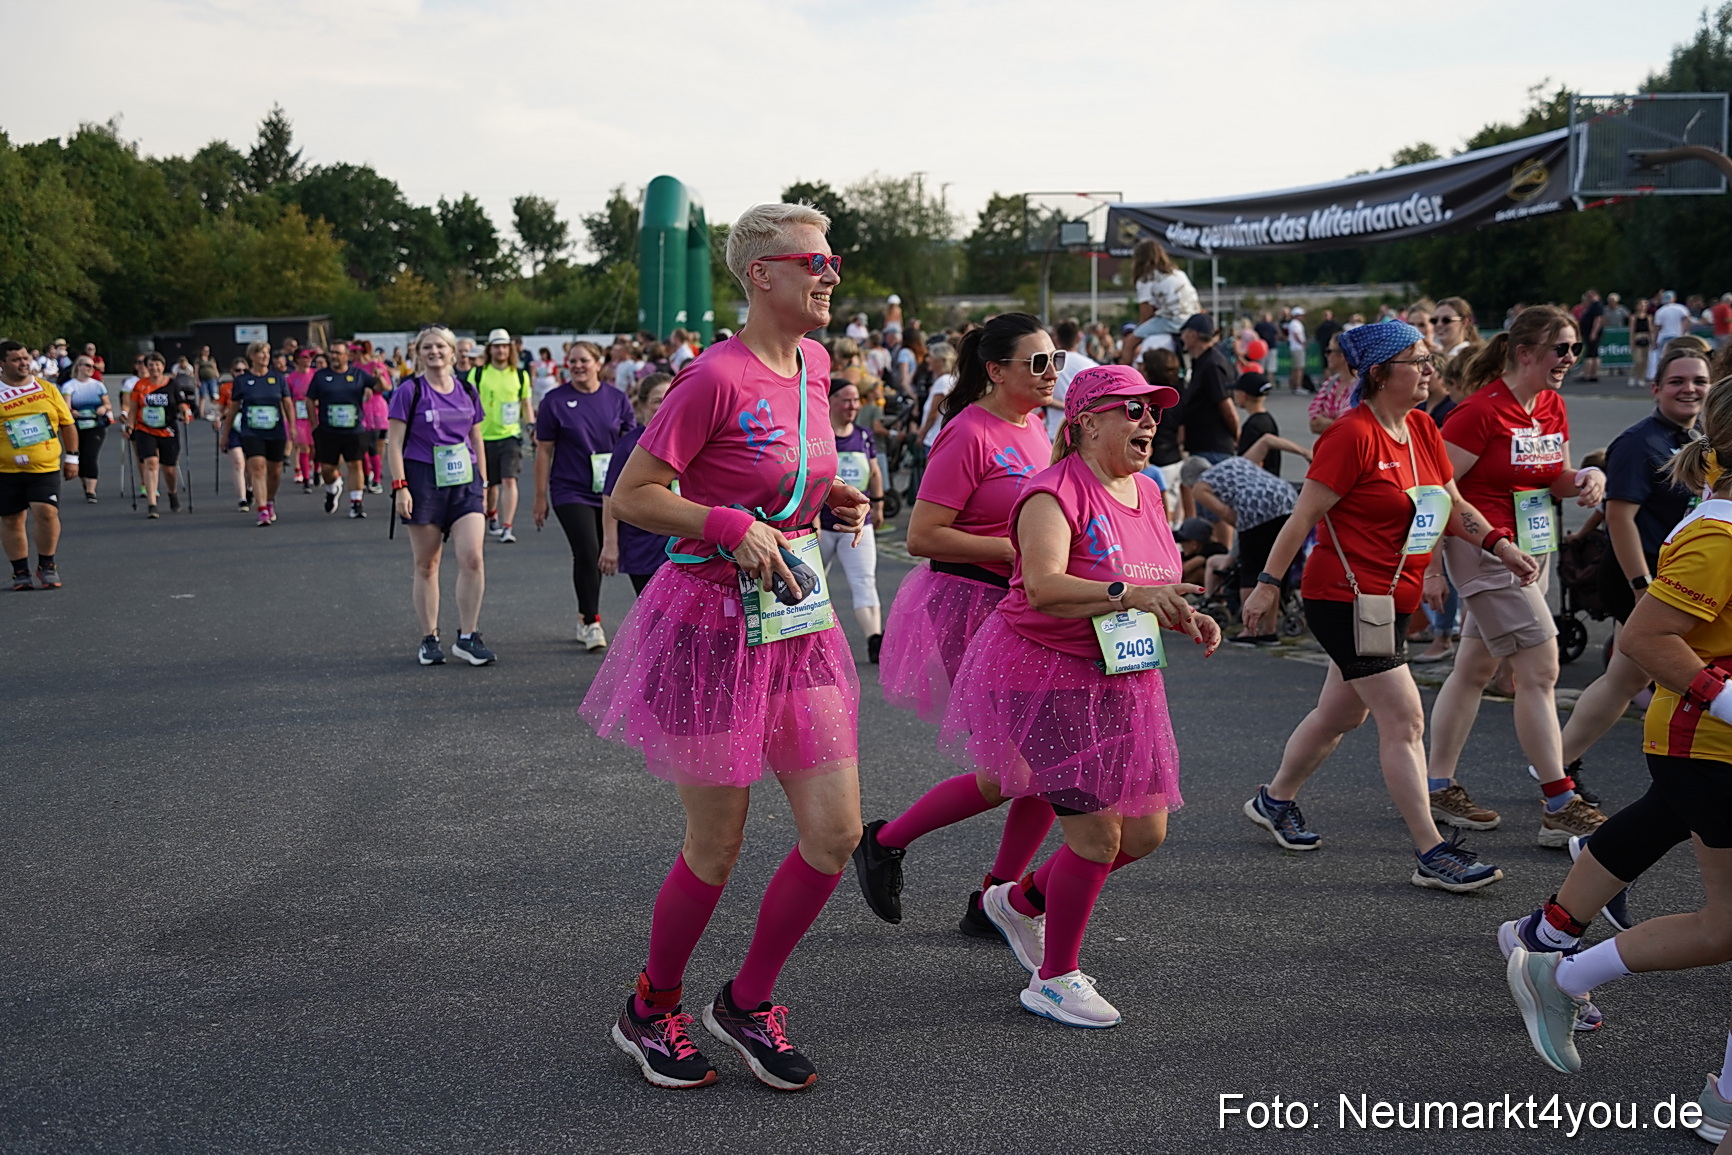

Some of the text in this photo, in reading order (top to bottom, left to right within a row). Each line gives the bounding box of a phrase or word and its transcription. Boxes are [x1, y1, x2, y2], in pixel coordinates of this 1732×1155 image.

[1166, 192, 1454, 254] Hier gewinnt das Miteinander.
[4, 393, 50, 411] MAX BÖGL
[22, 427, 39, 436] 1718
[447, 461, 463, 471] 819
[1416, 514, 1435, 528] 87
[762, 609, 785, 620] Denise
[1115, 638, 1155, 660] 2403
[1115, 659, 1160, 673] Loredana Stengel
[1041, 984, 1063, 1005] HOKA
